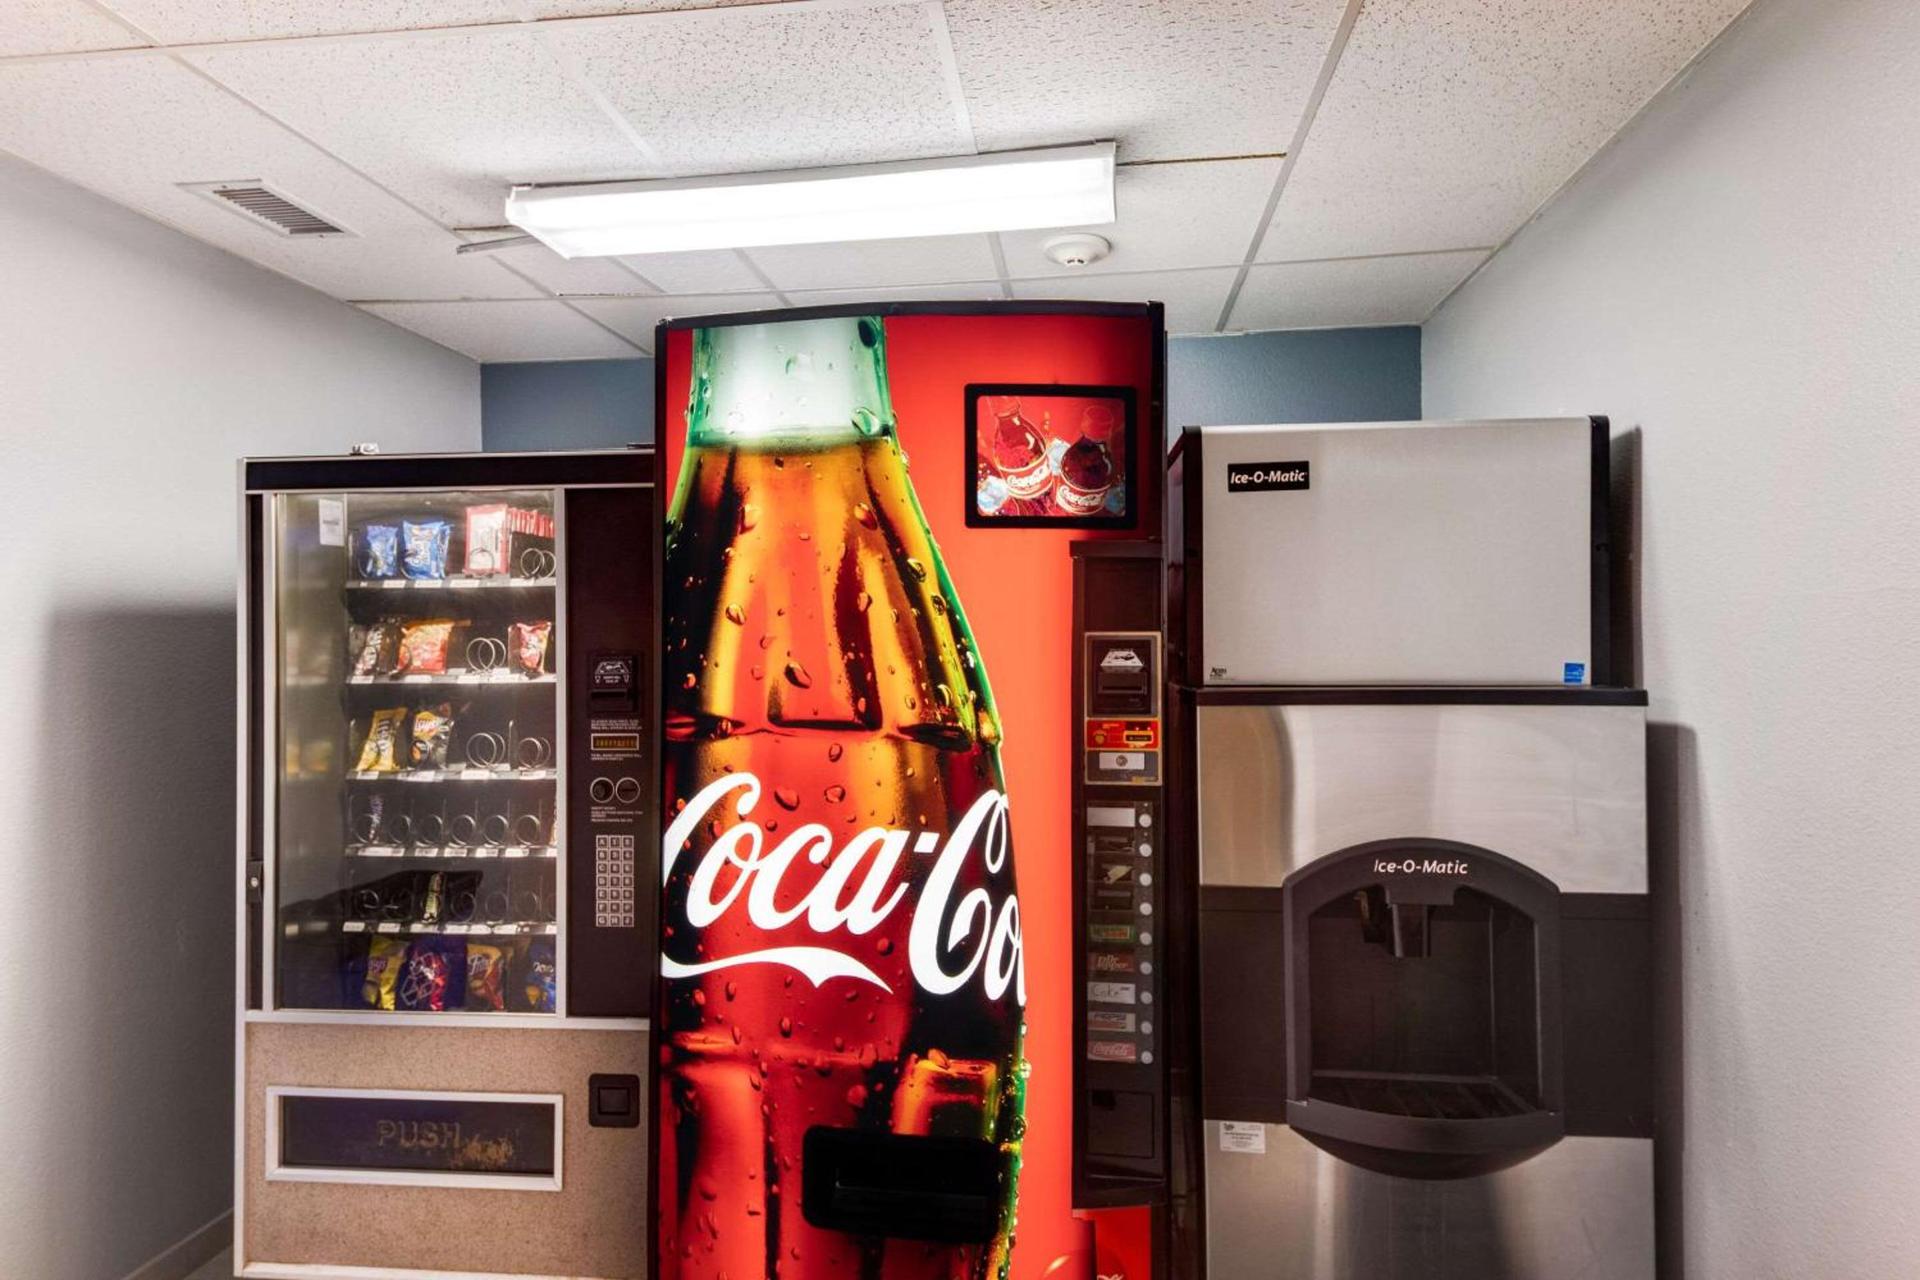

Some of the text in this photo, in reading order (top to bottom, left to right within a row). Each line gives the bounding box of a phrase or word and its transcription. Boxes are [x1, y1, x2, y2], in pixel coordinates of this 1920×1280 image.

[1230, 469, 1305, 484] Ice-O-Matic
[1374, 859, 1468, 874] Ice-O-Matic
[376, 1120, 461, 1148] PUSH
